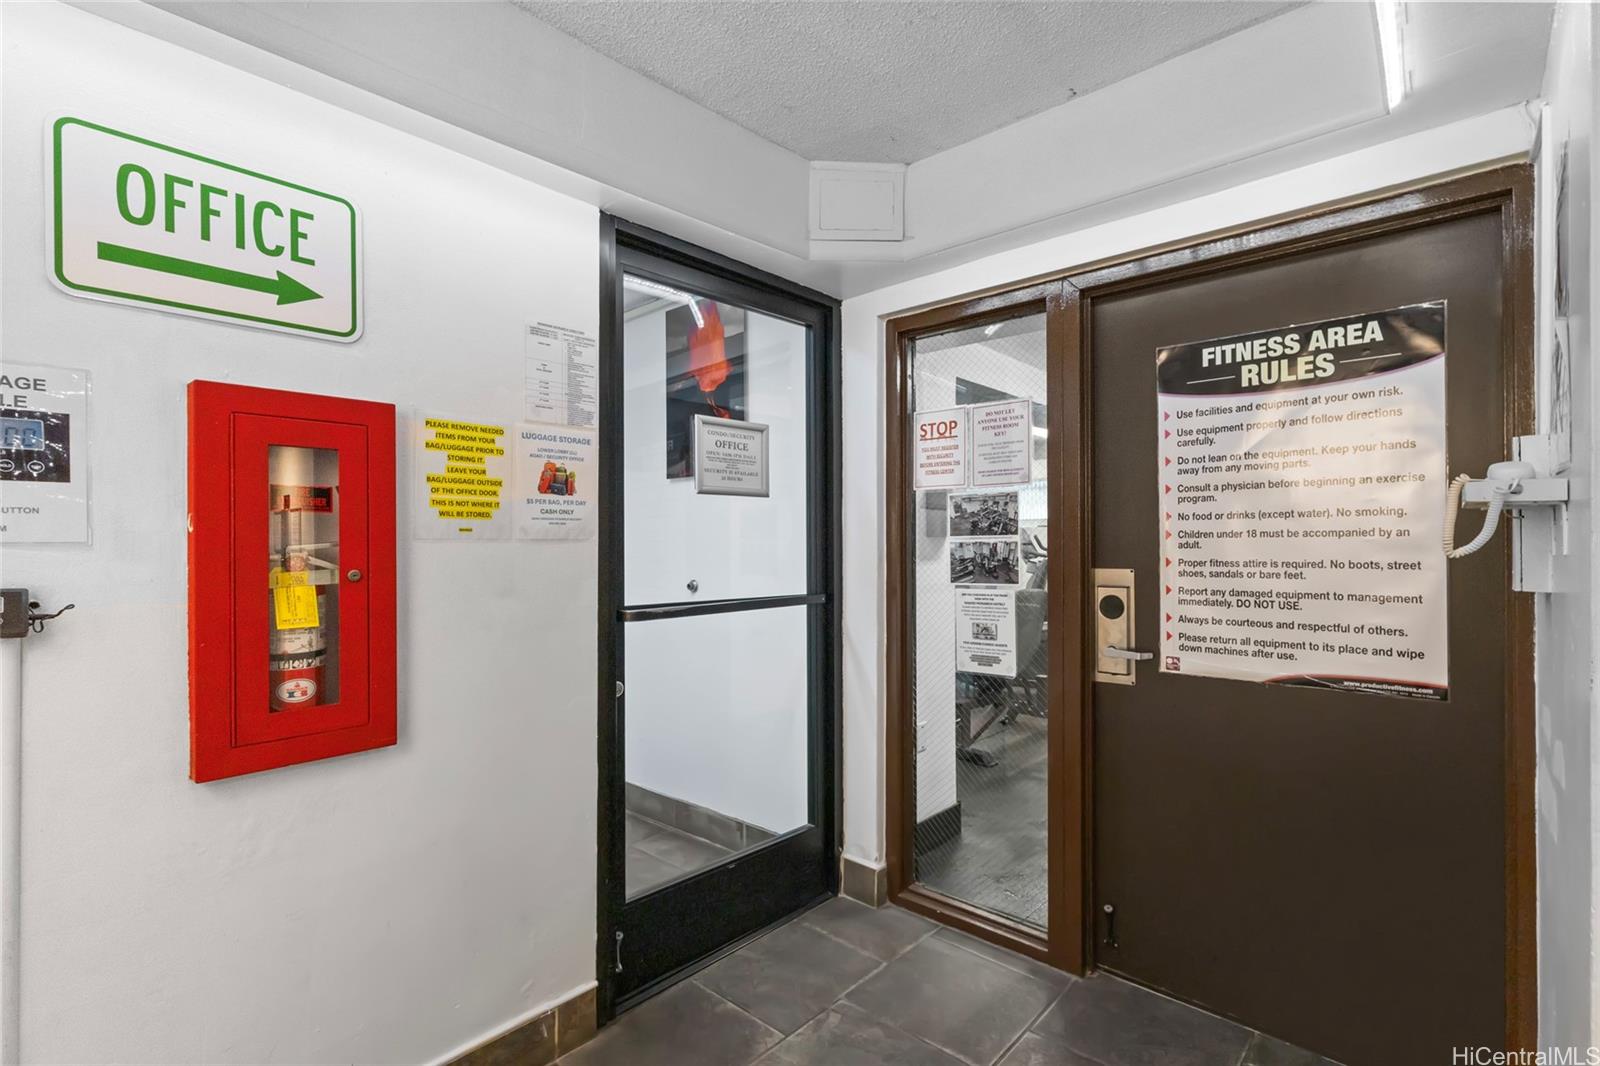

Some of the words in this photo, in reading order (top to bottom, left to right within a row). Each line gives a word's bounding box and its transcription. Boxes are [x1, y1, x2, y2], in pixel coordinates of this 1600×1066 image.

[116, 163, 316, 266] OFFICE
[1202, 333, 1300, 368] FITNESS
[1308, 320, 1384, 352] AREA
[1241, 353, 1336, 388] RULES
[1176, 410, 1194, 419] Use
[1195, 405, 1233, 417] facilities
[1235, 403, 1253, 413] and
[1256, 396, 1309, 412] equipment
[1311, 396, 1322, 405] at
[1324, 393, 1348, 405] your
[1352, 390, 1376, 400] own
[1379, 386, 1404, 398] risk.
[425, 420, 450, 429] PLEASE
[451, 424, 479, 433] REMOVE
[480, 427, 504, 435] NEEDED
[920, 420, 958, 438] STOP
[1176, 428, 1194, 437] Use
[1196, 423, 1244, 436] equipment
[1246, 419, 1286, 432] properly
[1289, 416, 1308, 426] and
[1311, 414, 1344, 424] follow
[1346, 408, 1403, 421] directions
[436, 432, 456, 440] ITEMS
[457, 434, 477, 442] FROM
[521, 432, 558, 442] LUGGAGE
[558, 436, 591, 446] STORAGE
[1177, 436, 1216, 448] carefully.
[425, 442, 474, 452] BAG/LUGGAGE
[476, 447, 495, 455] PRIOR
[715, 440, 749, 452] OFFICE
[1177, 456, 1190, 465] Do
[1192, 456, 1206, 464] not
[1208, 454, 1227, 463] lean
[1244, 451, 1260, 460] the
[1262, 447, 1318, 459] equipment.
[1321, 445, 1349, 456] Keep
[1352, 442, 1377, 454] your
[1380, 440, 1416, 451] hands
[447, 455, 476, 463] STORING
[469, 468, 486, 476] YOUR
[1177, 467, 1200, 476] away
[1202, 465, 1223, 474] from
[1225, 465, 1242, 474] any
[1244, 460, 1280, 472] moving
[1282, 459, 1312, 470] parts.
[426, 476, 475, 485] BAG/LUGGAGE
[1177, 483, 1211, 493] Consult
[1221, 480, 1266, 493] physician
[1268, 479, 1300, 489] before
[1303, 476, 1356, 488] beginning
[1359, 476, 1373, 484] an
[1376, 472, 1426, 484] exercise
[456, 488, 478, 496] OFFICE
[479, 489, 499, 497] DOOR.
[1177, 494, 1217, 504] program.
[1178, 513, 1190, 521] No
[1192, 512, 1212, 521] food
[1226, 510, 1256, 520] drinks
[1258, 510, 1295, 521] (except
[1297, 508, 1333, 519] water).
[1336, 508, 1352, 517] No
[1354, 506, 1408, 518] smoking.
[1178, 530, 1214, 539] Children
[1216, 530, 1243, 539] under
[1246, 529, 1257, 538] 18
[1260, 530, 1284, 538] must
[1286, 529, 1300, 538] be
[1302, 527, 1376, 539] accompanied
[1378, 527, 1393, 539] by
[1396, 529, 1411, 537] an
[1178, 540, 1202, 549] adult.
[1178, 558, 1207, 569] Proper
[1209, 558, 1240, 568] fitness
[1242, 559, 1268, 568] attire
[1270, 559, 1279, 568] is
[1281, 559, 1327, 570] required.
[1330, 559, 1345, 569] No
[1348, 560, 1384, 571] boots,
[1387, 561, 1422, 570] street
[1178, 569, 1207, 579] shoes,
[1209, 570, 1244, 579] sandals
[1246, 571, 1257, 579] or
[1259, 570, 1281, 579] bare
[1283, 570, 1307, 580] feet.
[1178, 586, 1208, 597] Report
[1210, 589, 1227, 599] any
[1228, 588, 1273, 599] damaged
[1275, 590, 1330, 601] equipment
[1333, 591, 1344, 601] to
[1347, 593, 1423, 605] management
[1178, 597, 1234, 609] immediately.
[1236, 599, 1251, 608] DO
[1254, 600, 1276, 609] NOT
[1278, 600, 1303, 611] USE.
[1178, 615, 1209, 626] Always
[1211, 617, 1223, 625] be
[1225, 619, 1274, 629] courteous
[1276, 620, 1295, 630] and
[1297, 622, 1350, 633] respectful
[1353, 624, 1365, 634] of
[1368, 626, 1408, 637] others.
[1178, 632, 1208, 643] Please
[1209, 636, 1238, 645] return
[1239, 637, 1251, 646] all
[1253, 639, 1306, 650] equipment
[1309, 642, 1320, 651] to
[1322, 642, 1336, 653] its
[1338, 644, 1368, 656] place
[1371, 647, 1393, 657] and
[1397, 649, 1425, 661] wipe
[1178, 643, 1203, 653] down
[1204, 646, 1249, 657] machines
[1251, 648, 1274, 659] after
[1276, 651, 1298, 661] use.
[1344, 681, 1434, 694] www.productivefitness.com
